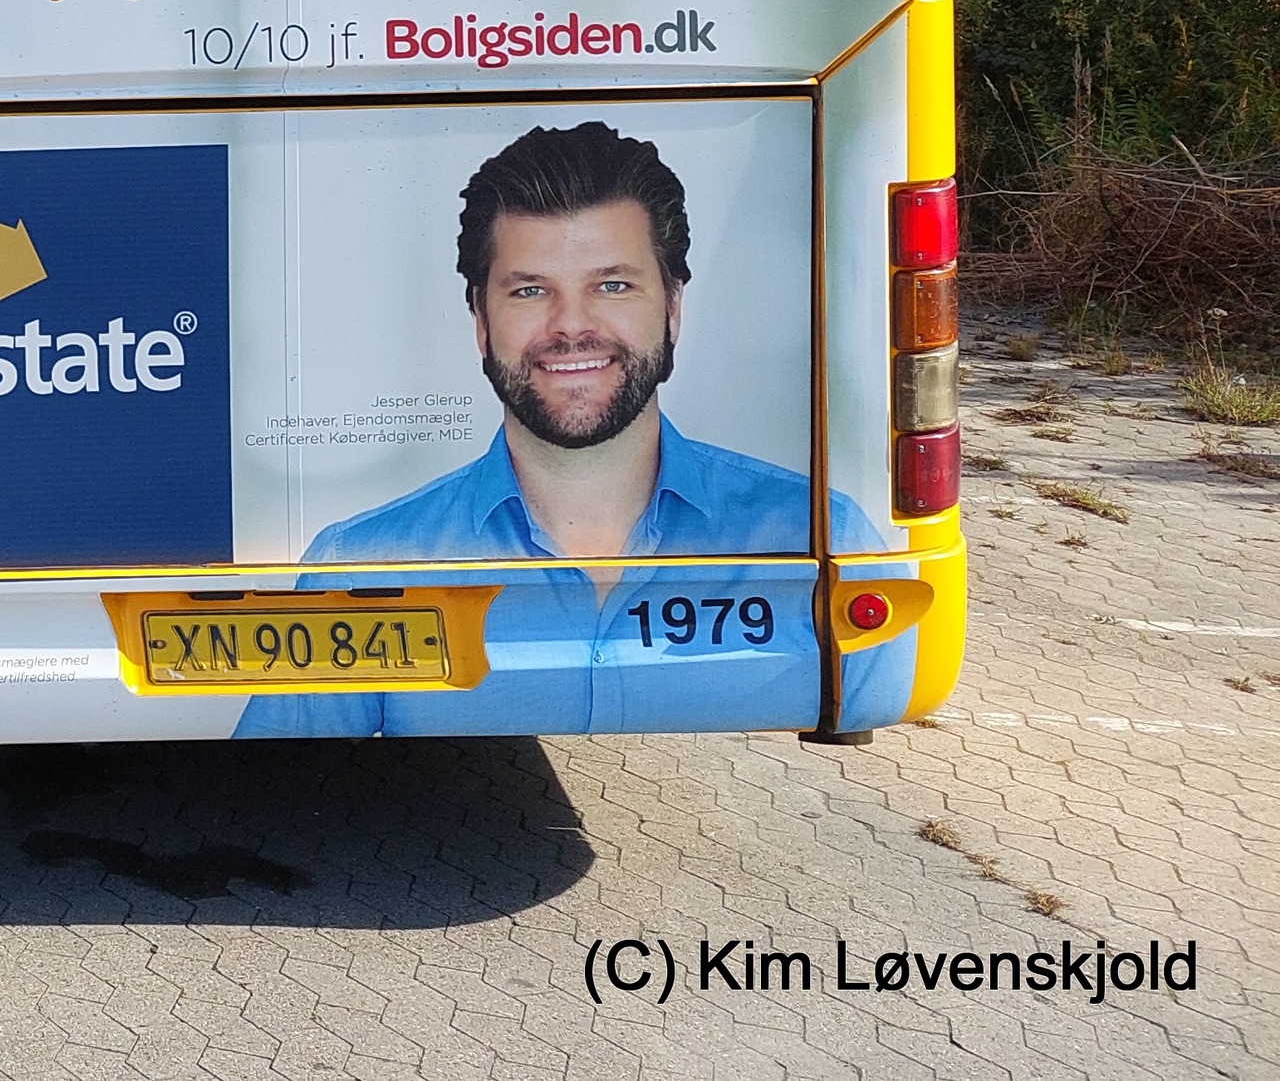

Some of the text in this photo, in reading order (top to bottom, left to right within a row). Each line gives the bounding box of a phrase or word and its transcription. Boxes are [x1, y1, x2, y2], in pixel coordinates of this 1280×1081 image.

[183, 10, 718, 70] 10/10 jf. Boligsiden.dk
[371, 395, 420, 409] Jesper
[245, 428, 473, 446] Certificeret Køberrådgiver, MDE
[628, 596, 774, 648] 1979
[61, 654, 89, 666] med
[171, 621, 418, 672] XN 90 841
